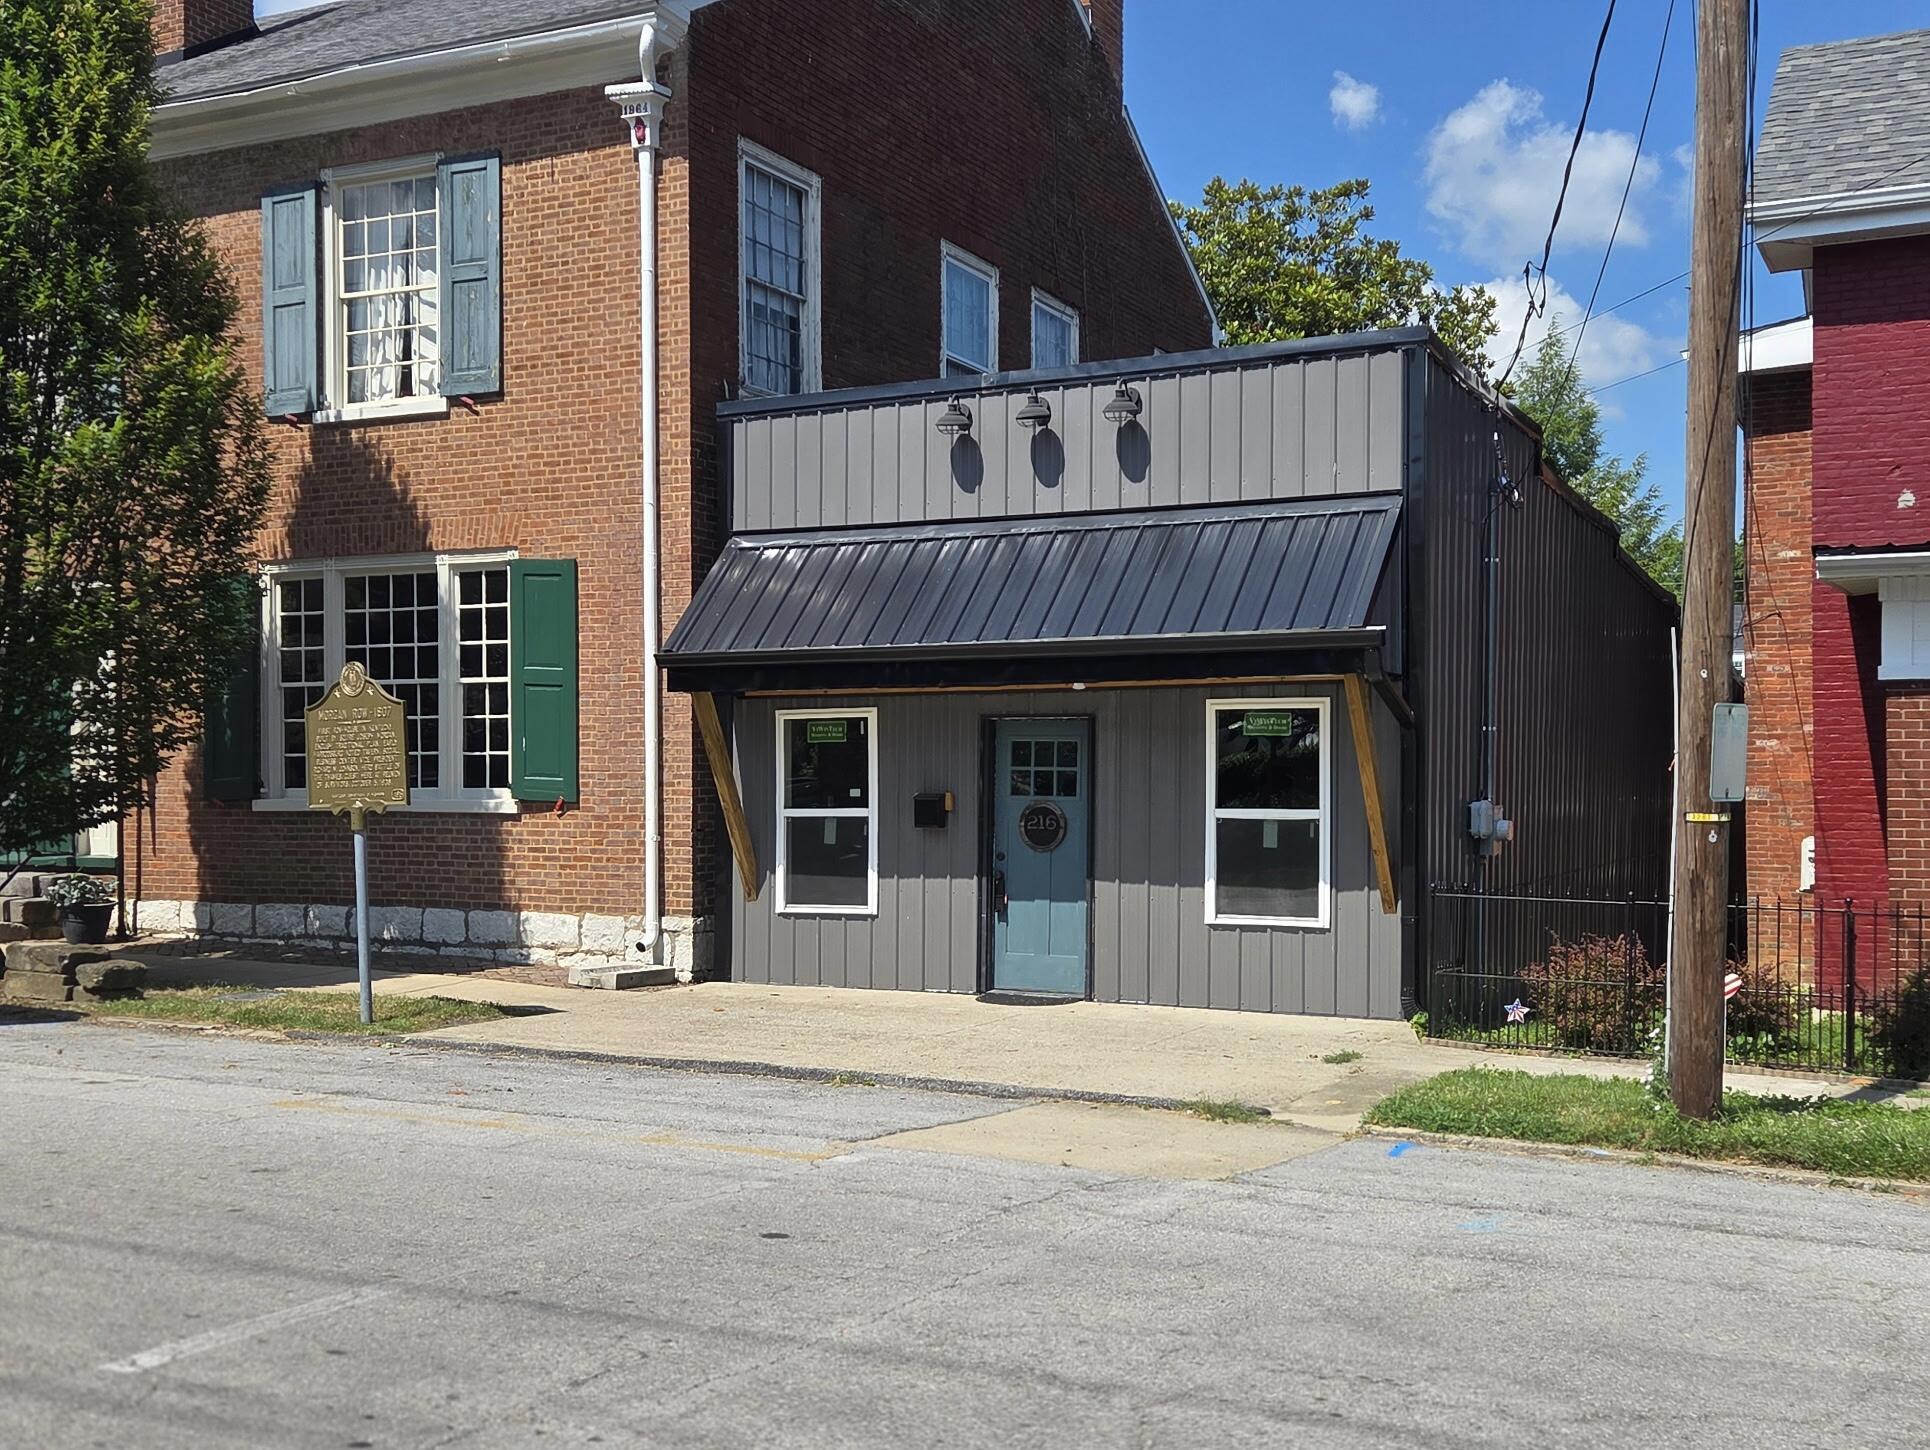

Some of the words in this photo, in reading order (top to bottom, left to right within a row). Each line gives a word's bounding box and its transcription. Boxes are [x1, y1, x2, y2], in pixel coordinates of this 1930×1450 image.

[623, 102, 648, 115] 1964
[318, 708, 347, 720] MORGAN
[1027, 815, 1057, 830] 216
